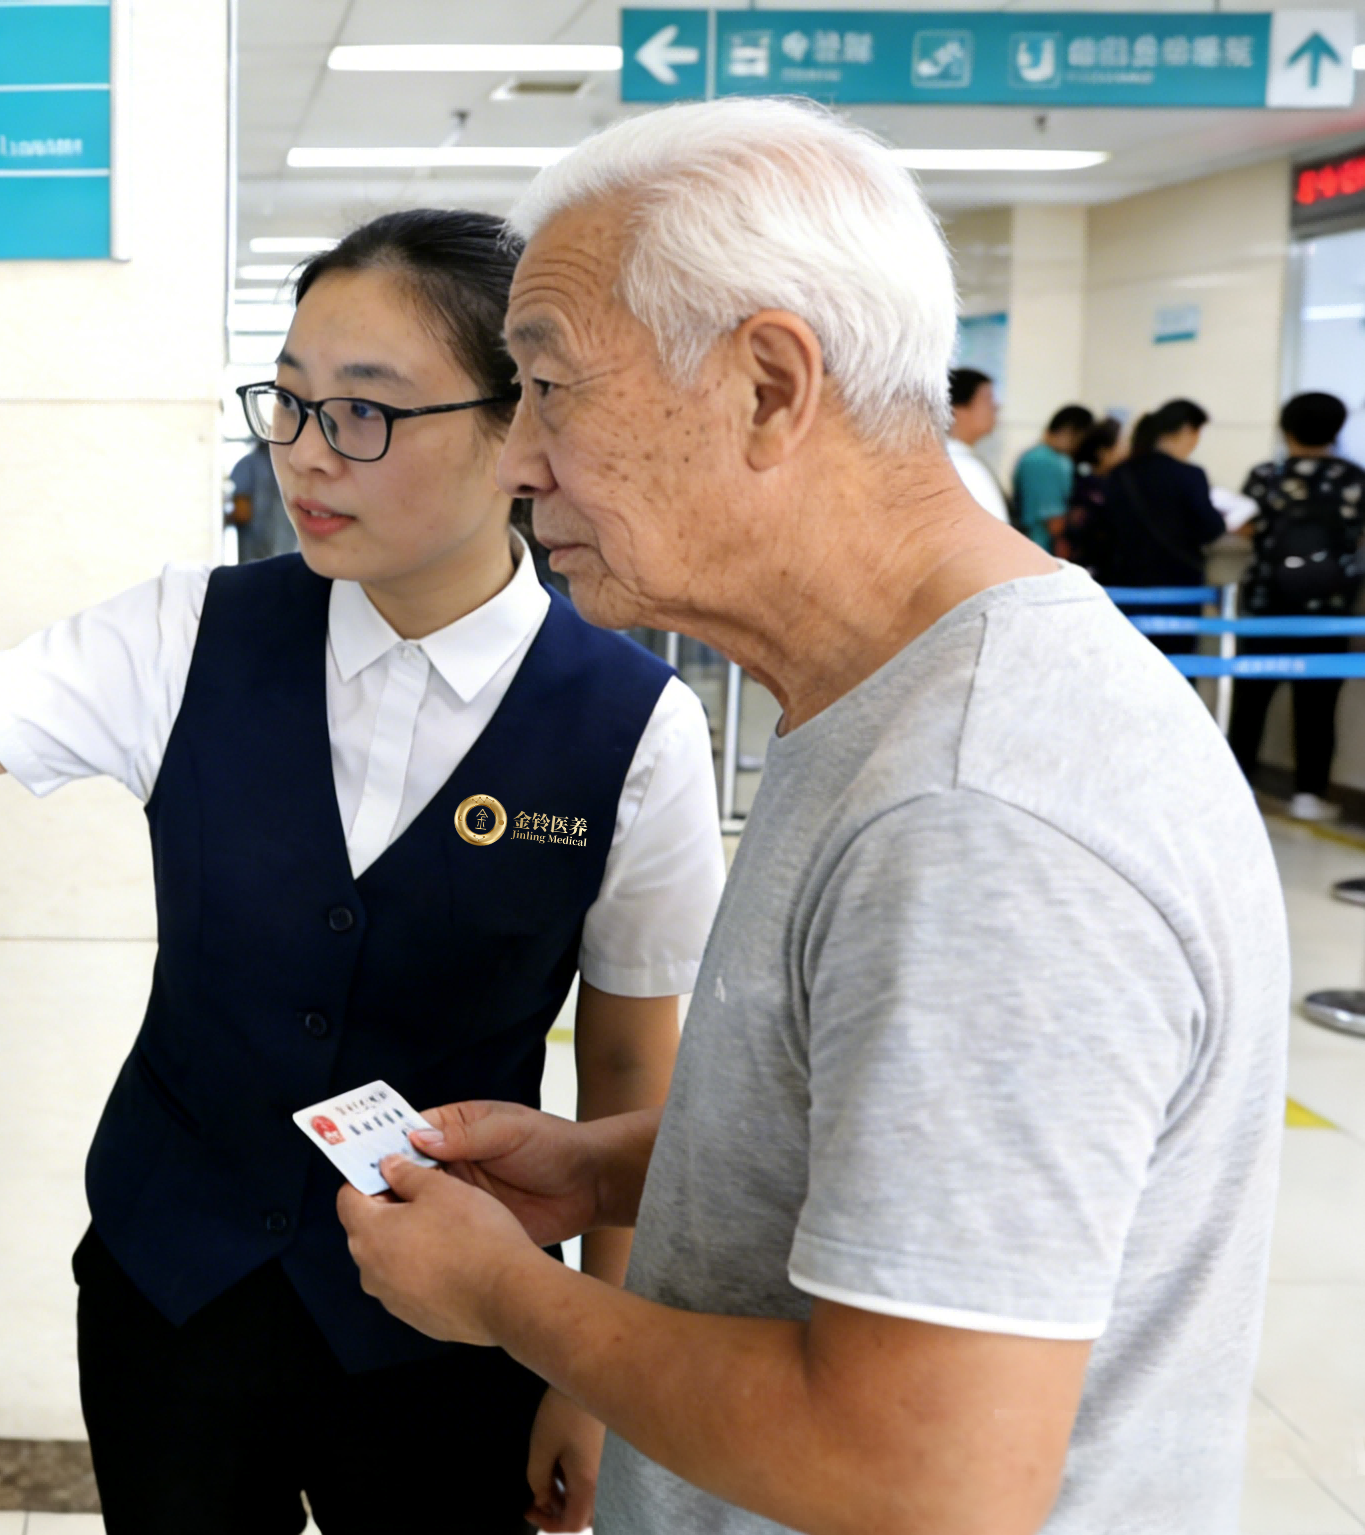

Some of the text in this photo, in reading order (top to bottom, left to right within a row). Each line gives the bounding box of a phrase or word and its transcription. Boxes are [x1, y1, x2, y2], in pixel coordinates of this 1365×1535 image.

[512, 811, 588, 837] 金铃医养
[511, 830, 588, 847] Jinling Medical
